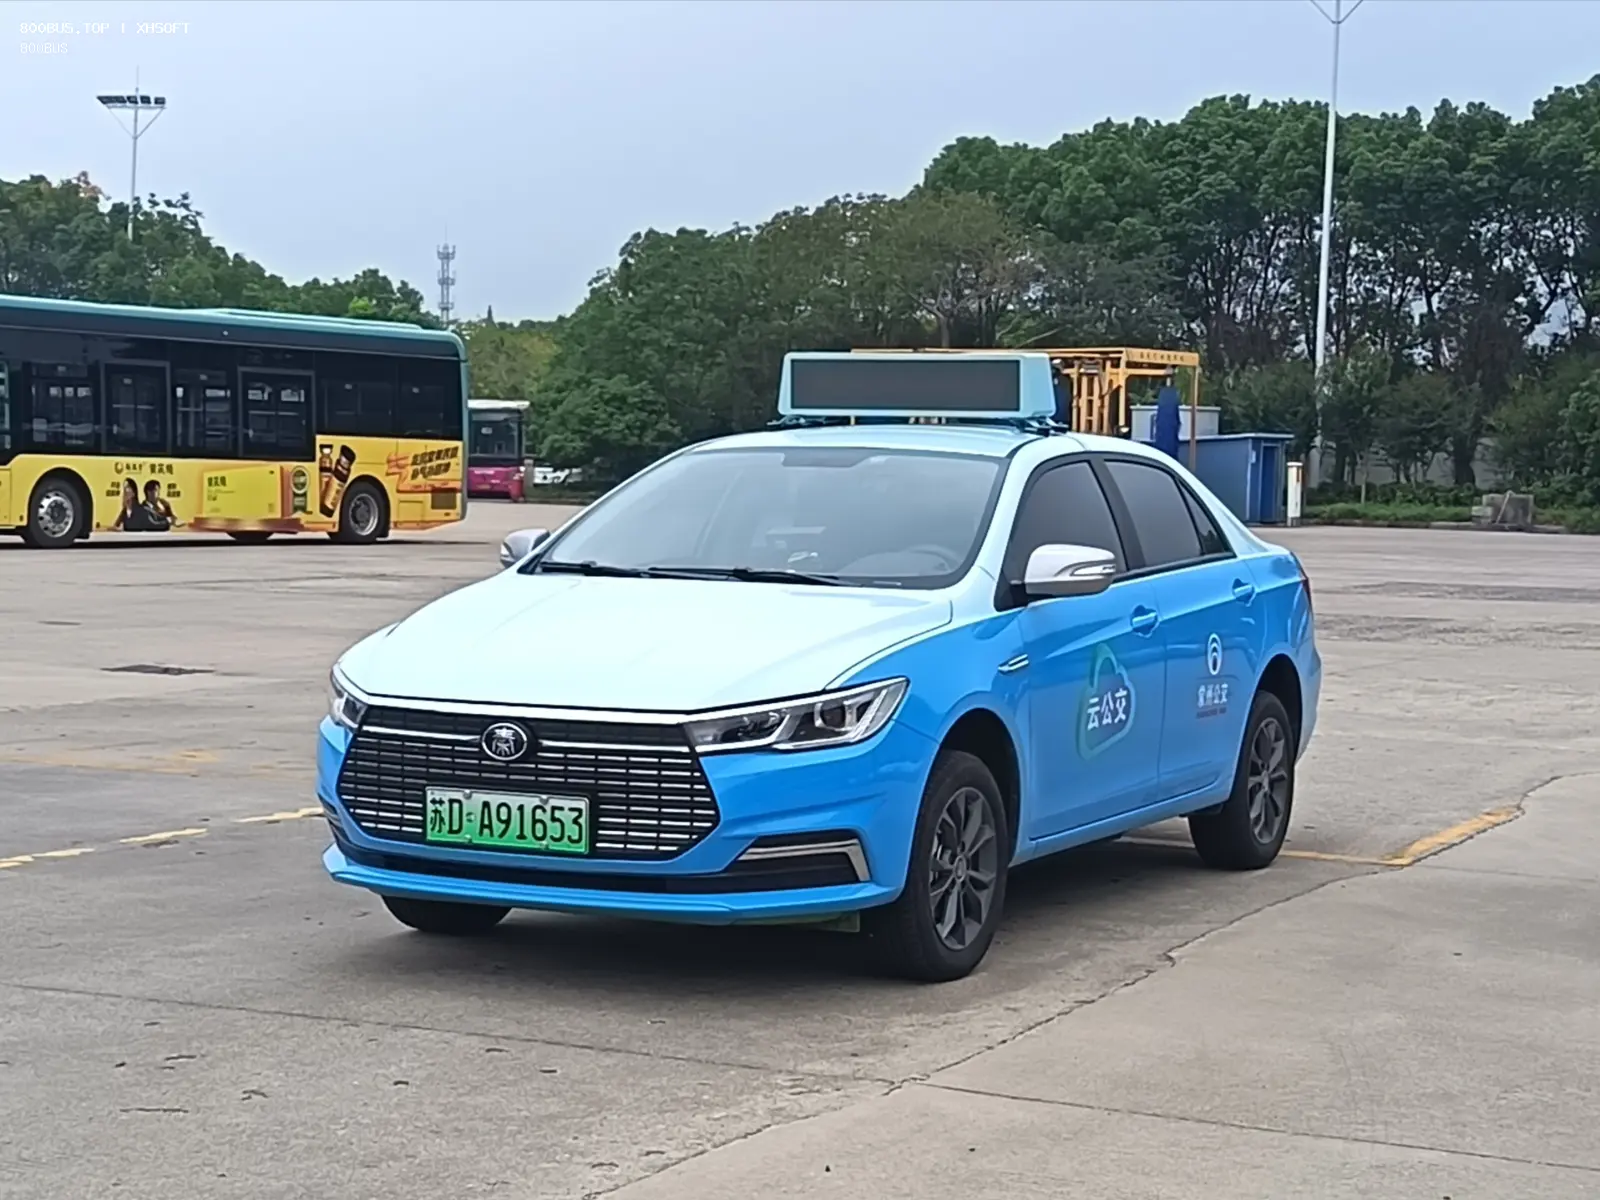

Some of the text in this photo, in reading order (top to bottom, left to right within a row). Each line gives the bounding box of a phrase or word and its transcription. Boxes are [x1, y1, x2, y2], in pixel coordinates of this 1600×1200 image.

[1087, 687, 1128, 731] 云公交
[429, 797, 584, 844] 苏D A91653
